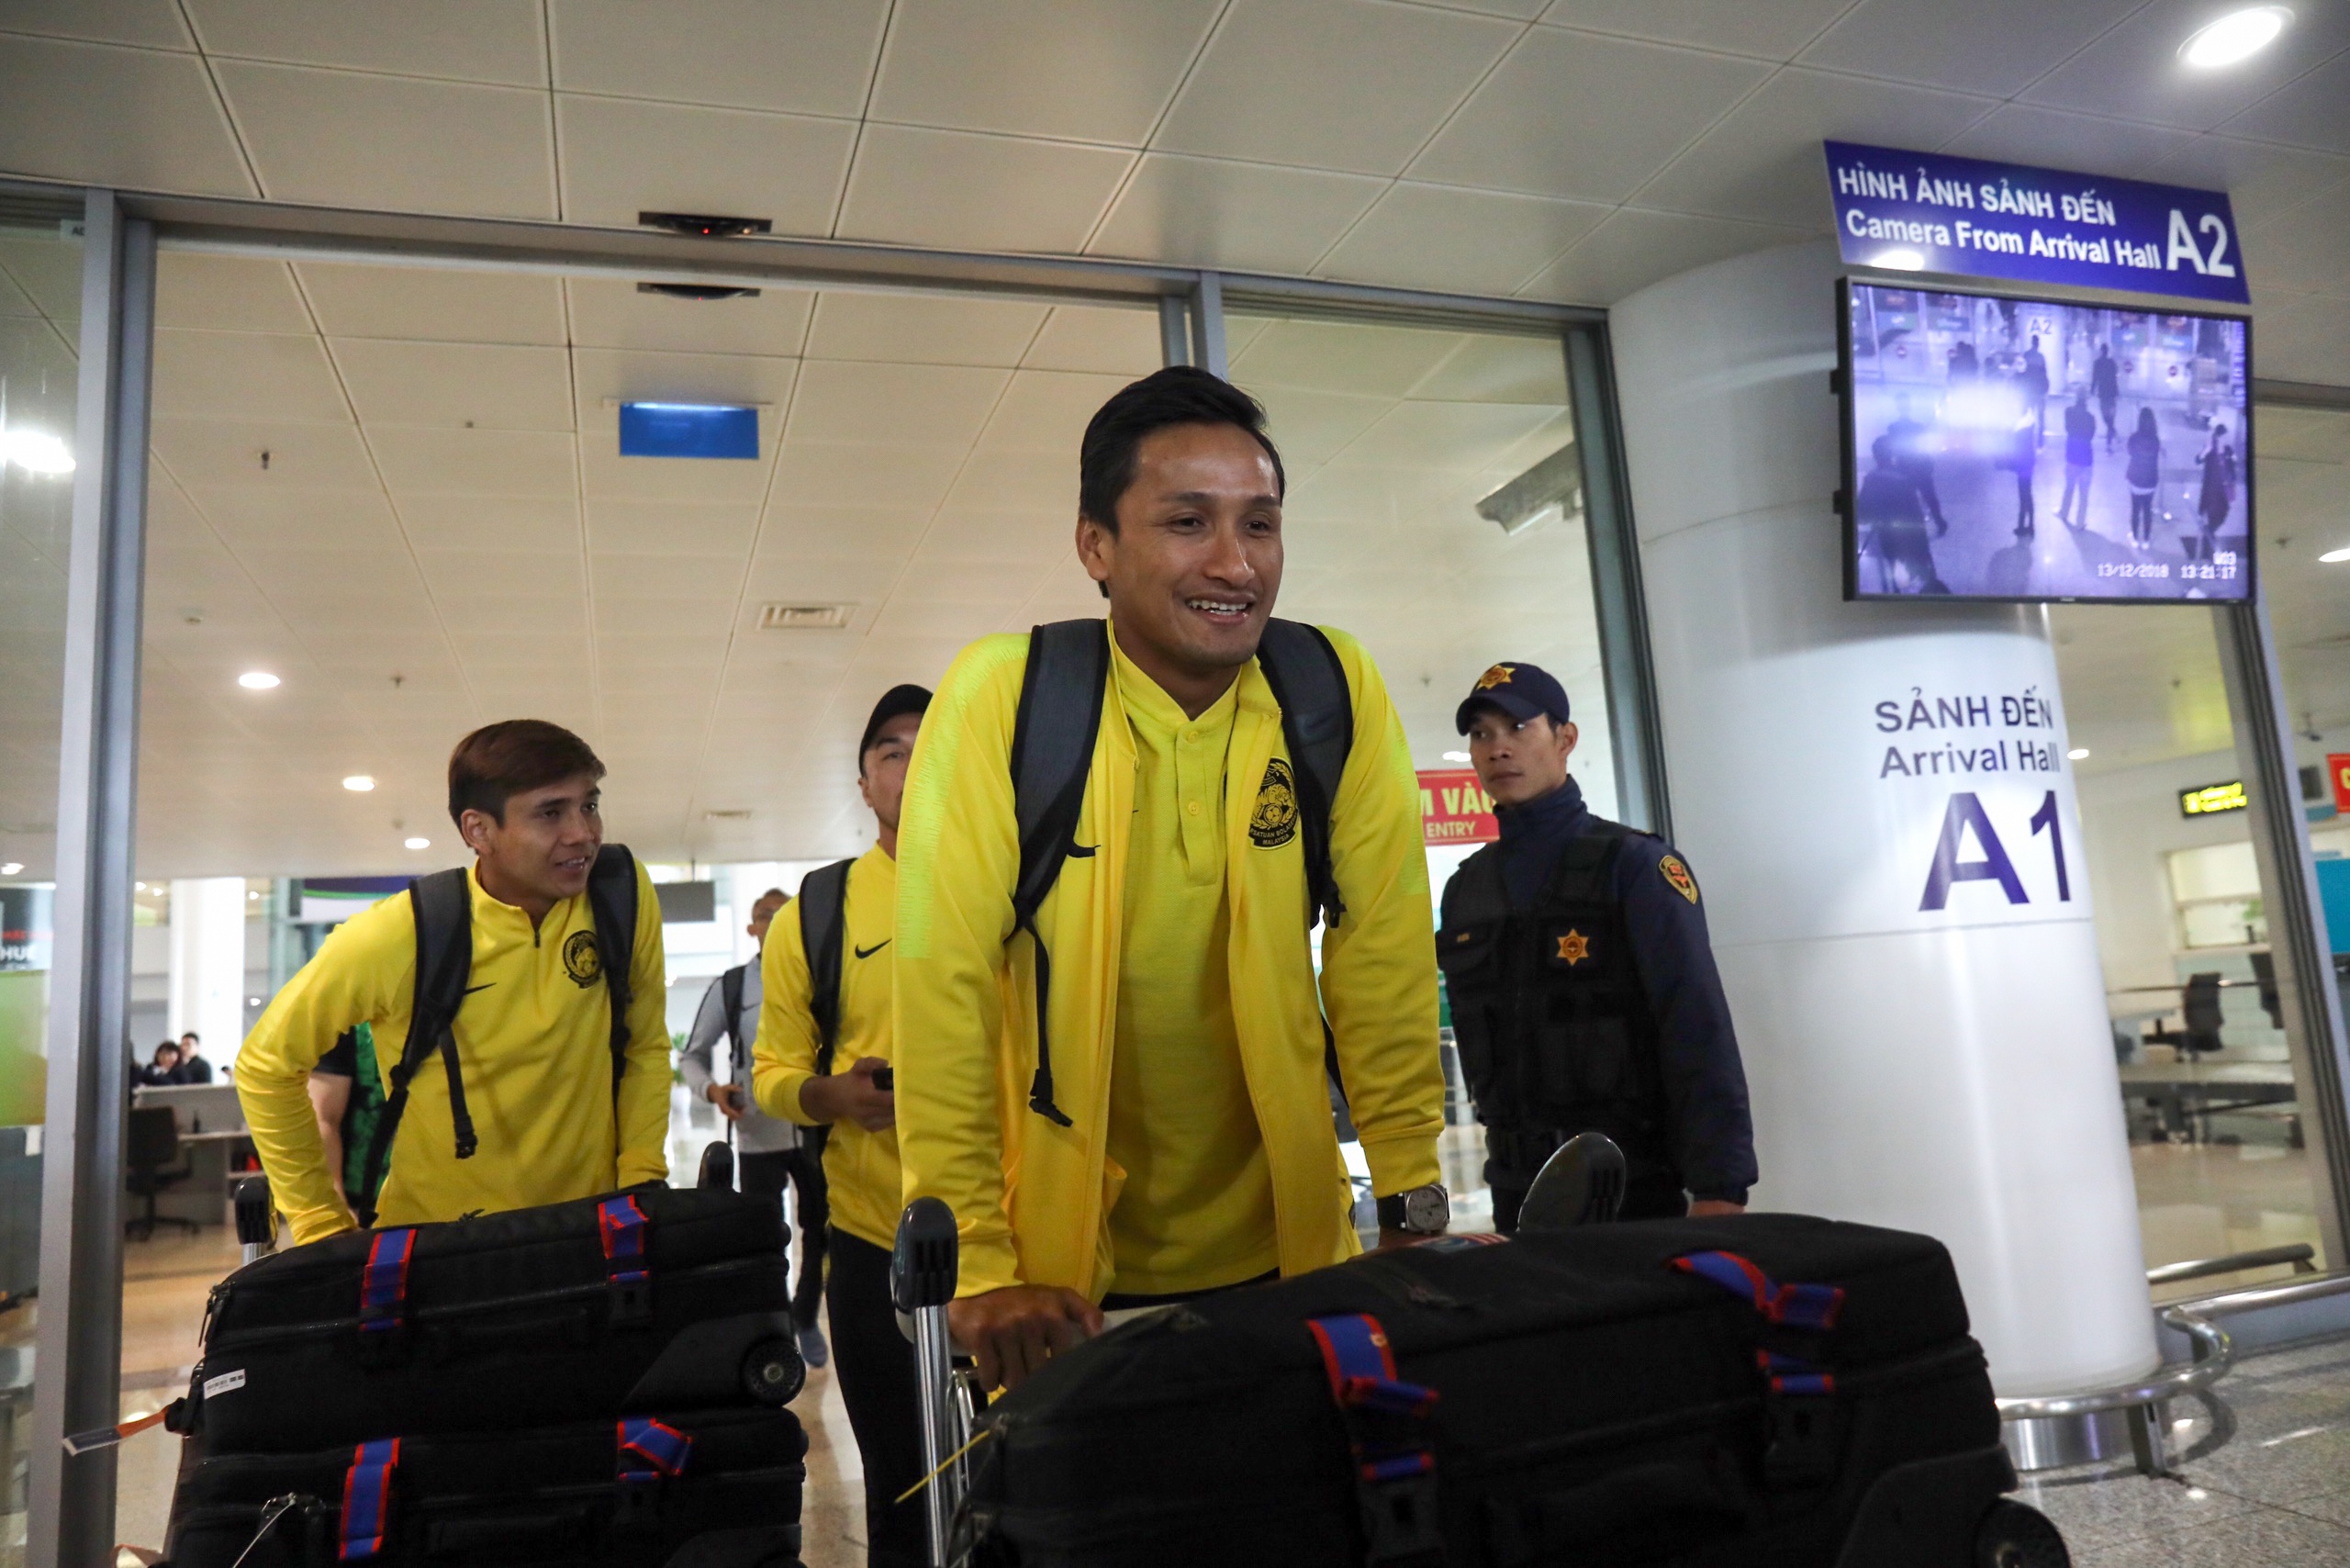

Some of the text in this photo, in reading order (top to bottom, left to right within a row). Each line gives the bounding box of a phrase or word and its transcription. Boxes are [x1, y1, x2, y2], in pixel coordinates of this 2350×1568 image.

[1838, 162, 2117, 226] HÌNH ẢNH SẢNH ĐẾN
[1846, 209, 2162, 270] Camera From Arrival Hall
[2166, 208, 2236, 278] A2
[1874, 685, 2053, 734] SẢNH ĐẾN
[1880, 740, 2061, 778] Arrival Hall
[1262, 834, 1290, 846] MALAYSIA
[1427, 822, 1476, 838] ENTRY
[1918, 790, 2071, 912] A1
